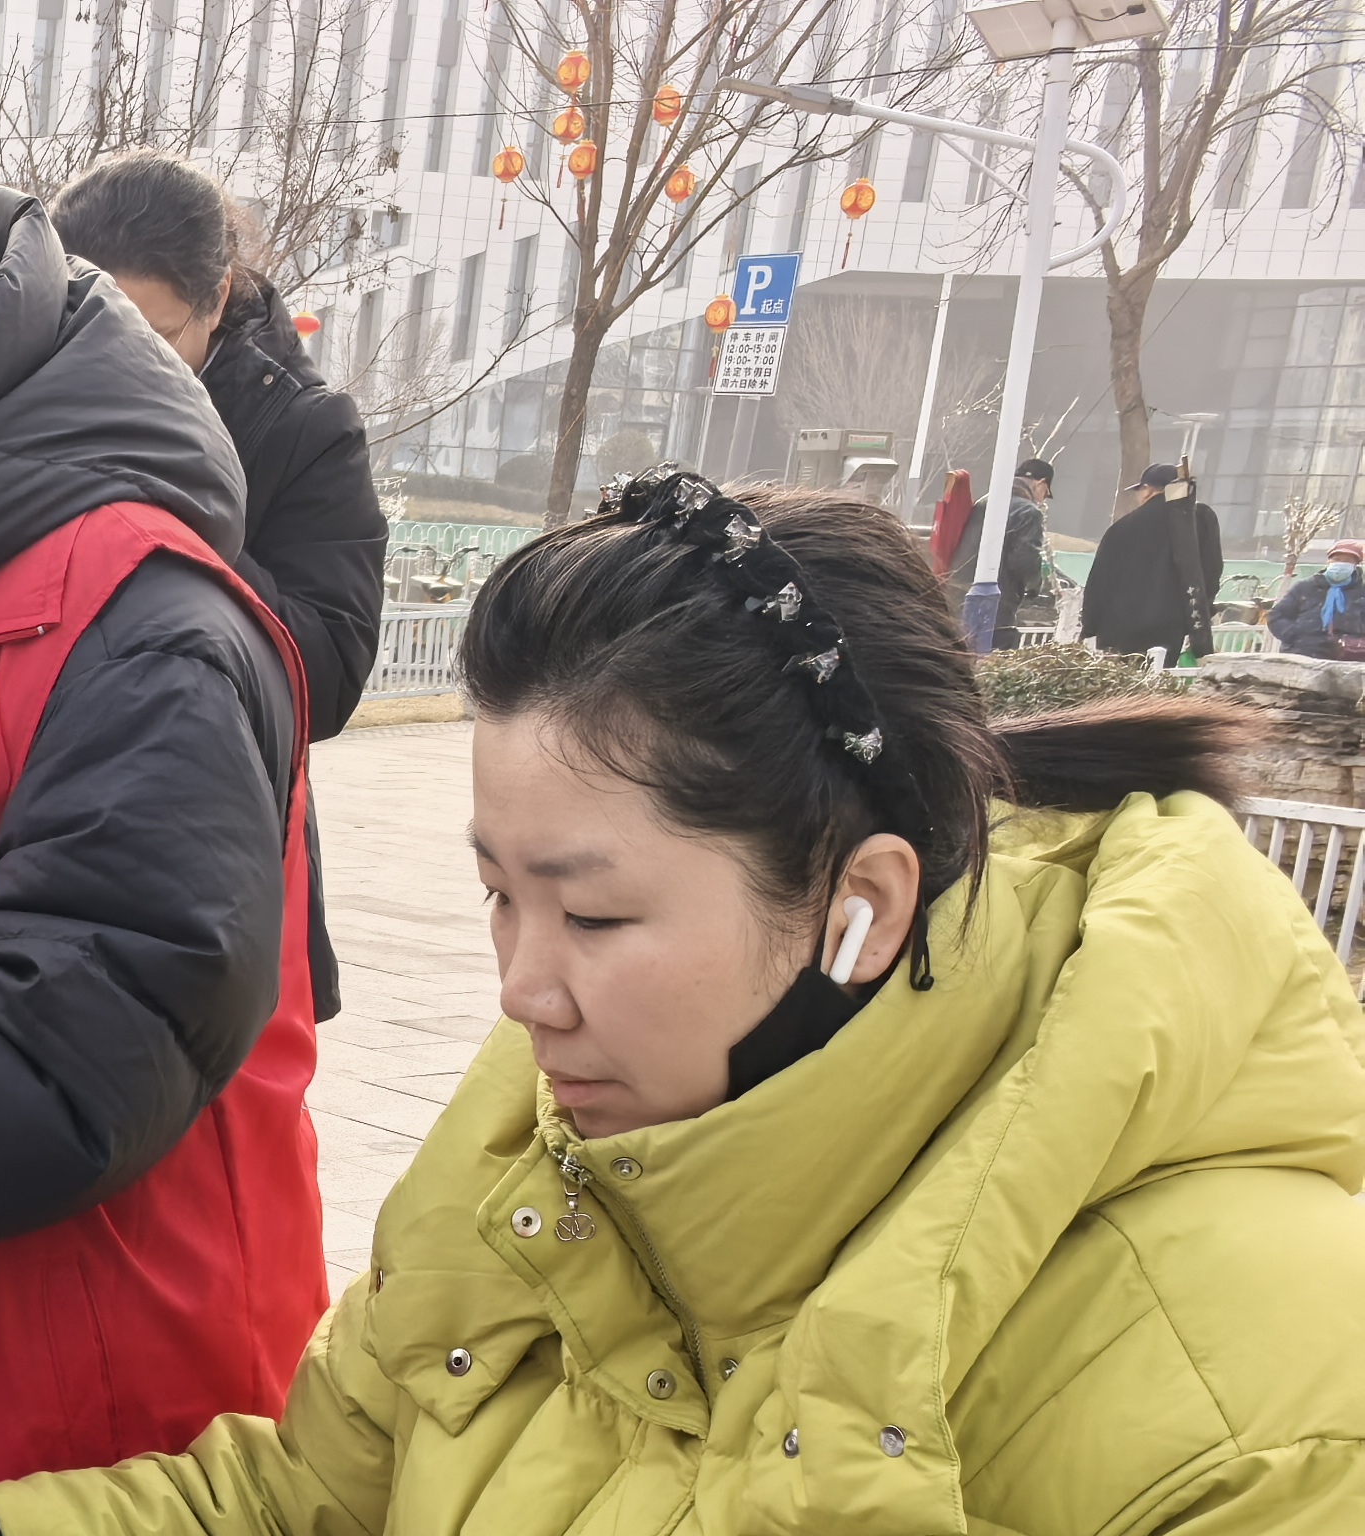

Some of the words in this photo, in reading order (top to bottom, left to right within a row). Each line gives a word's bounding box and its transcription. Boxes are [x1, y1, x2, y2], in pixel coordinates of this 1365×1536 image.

[740, 265, 773, 316] P
[760, 299, 785, 314] 起点
[730, 332, 779, 342] 停车时间
[727, 344, 777, 353] 12:00-15:00
[722, 367, 772, 377] 法定节假日
[720, 379, 769, 389] 周六日除外
